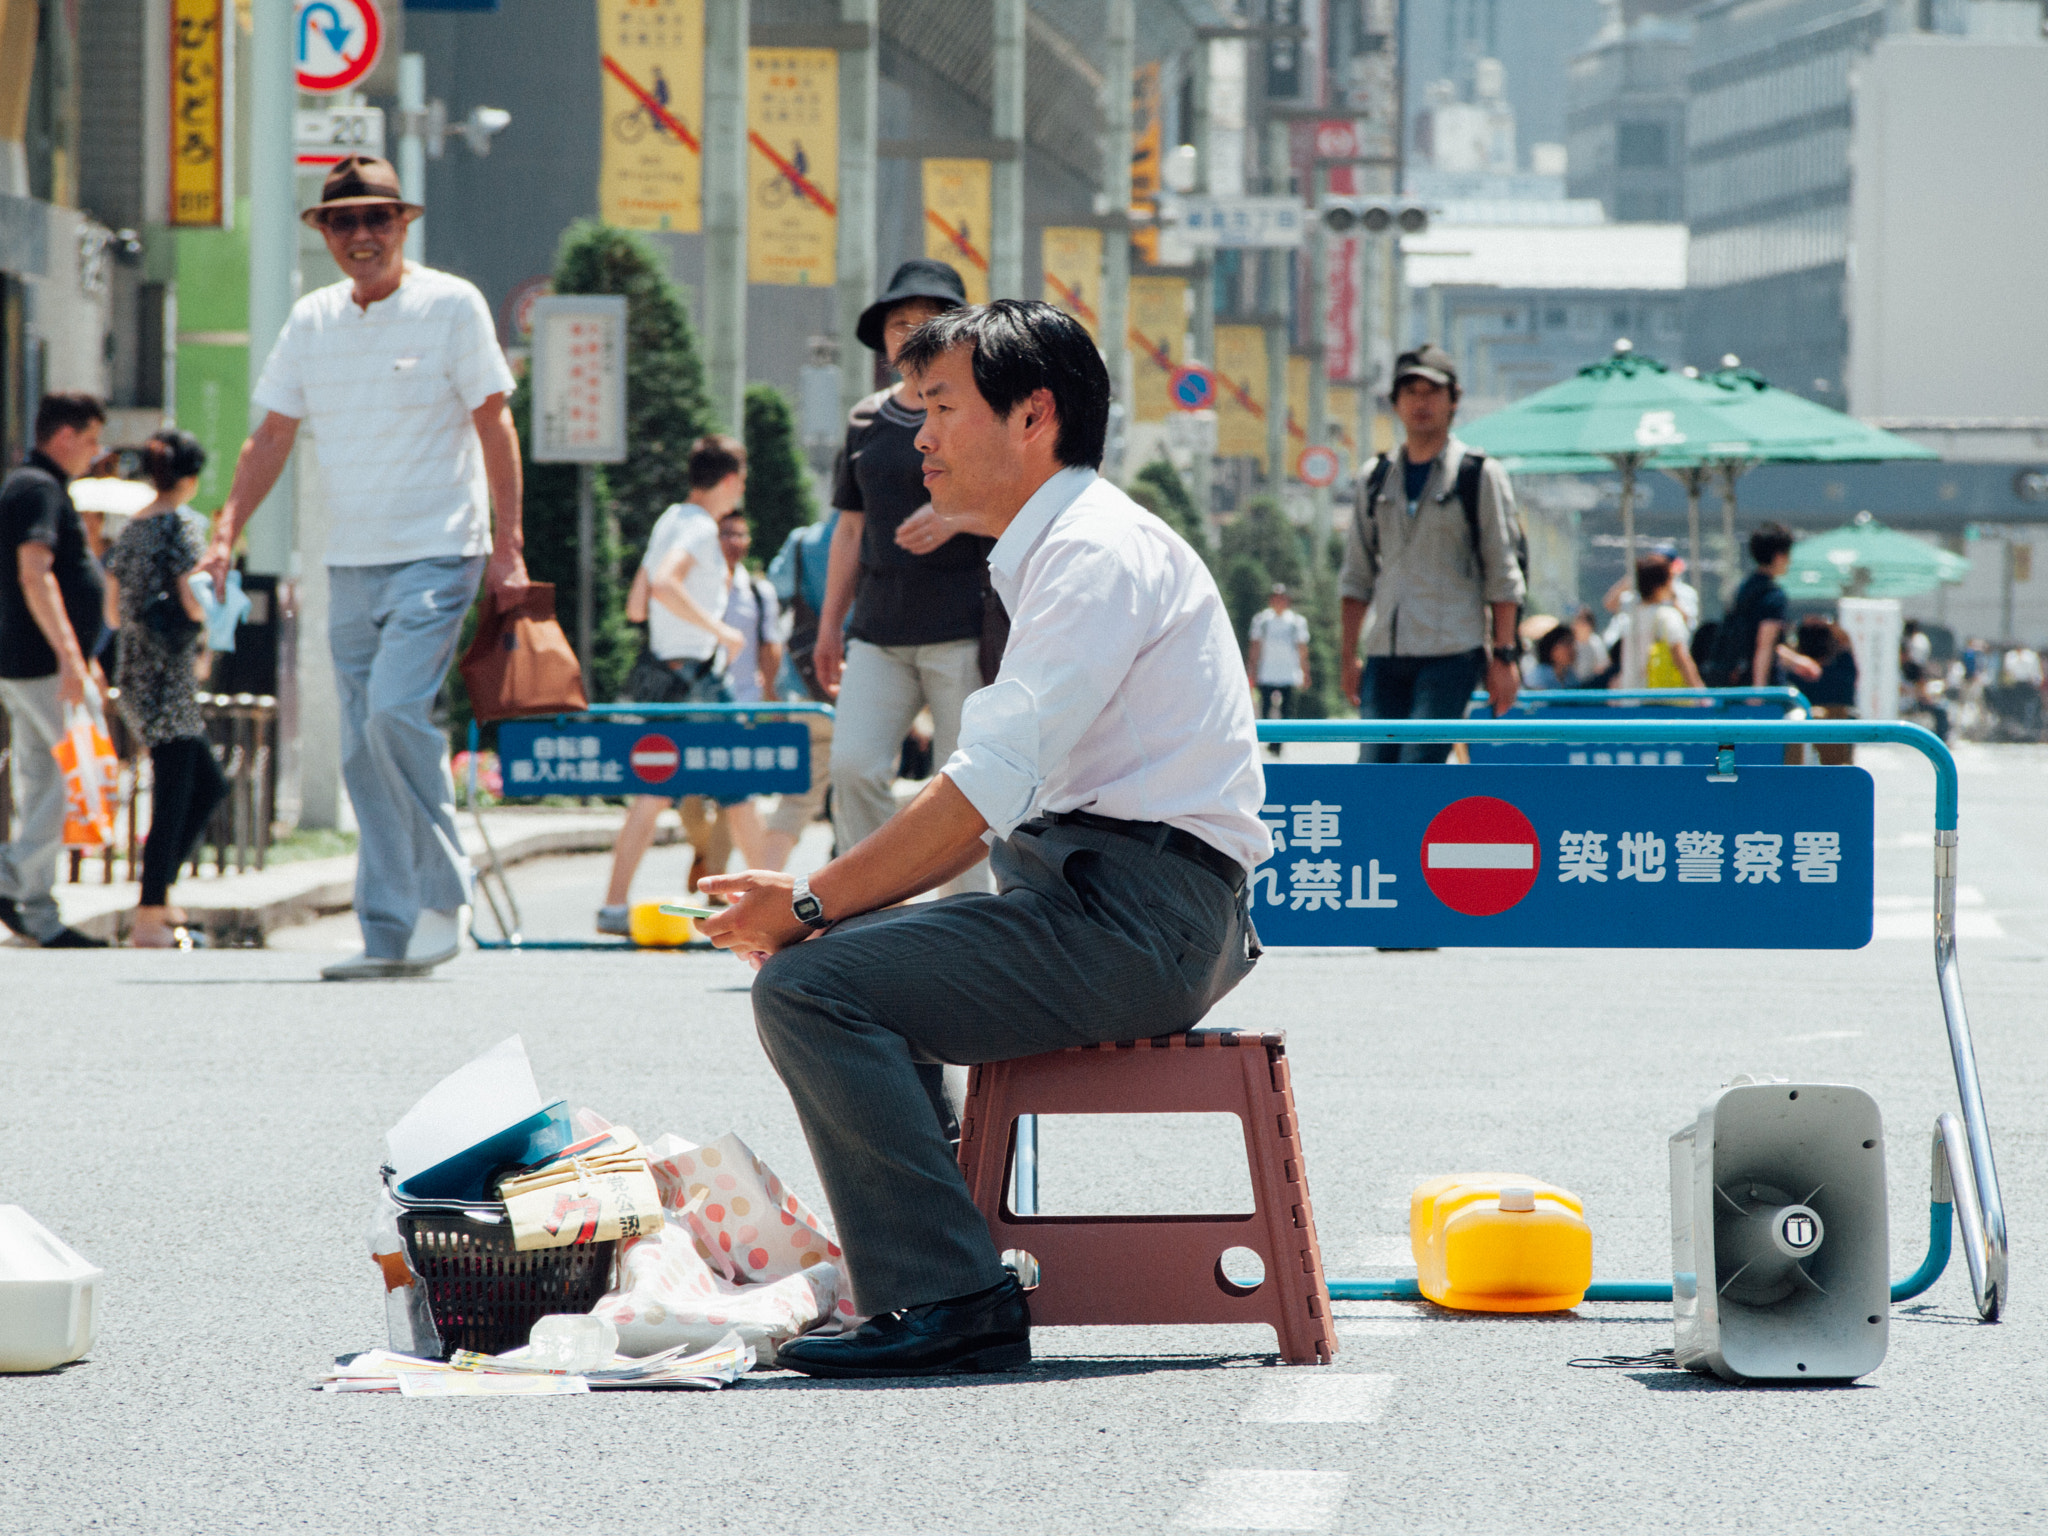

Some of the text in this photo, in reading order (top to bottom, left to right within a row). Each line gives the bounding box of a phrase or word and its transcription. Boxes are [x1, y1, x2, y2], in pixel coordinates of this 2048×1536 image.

[1557, 830, 1843, 884] 築地警察署
